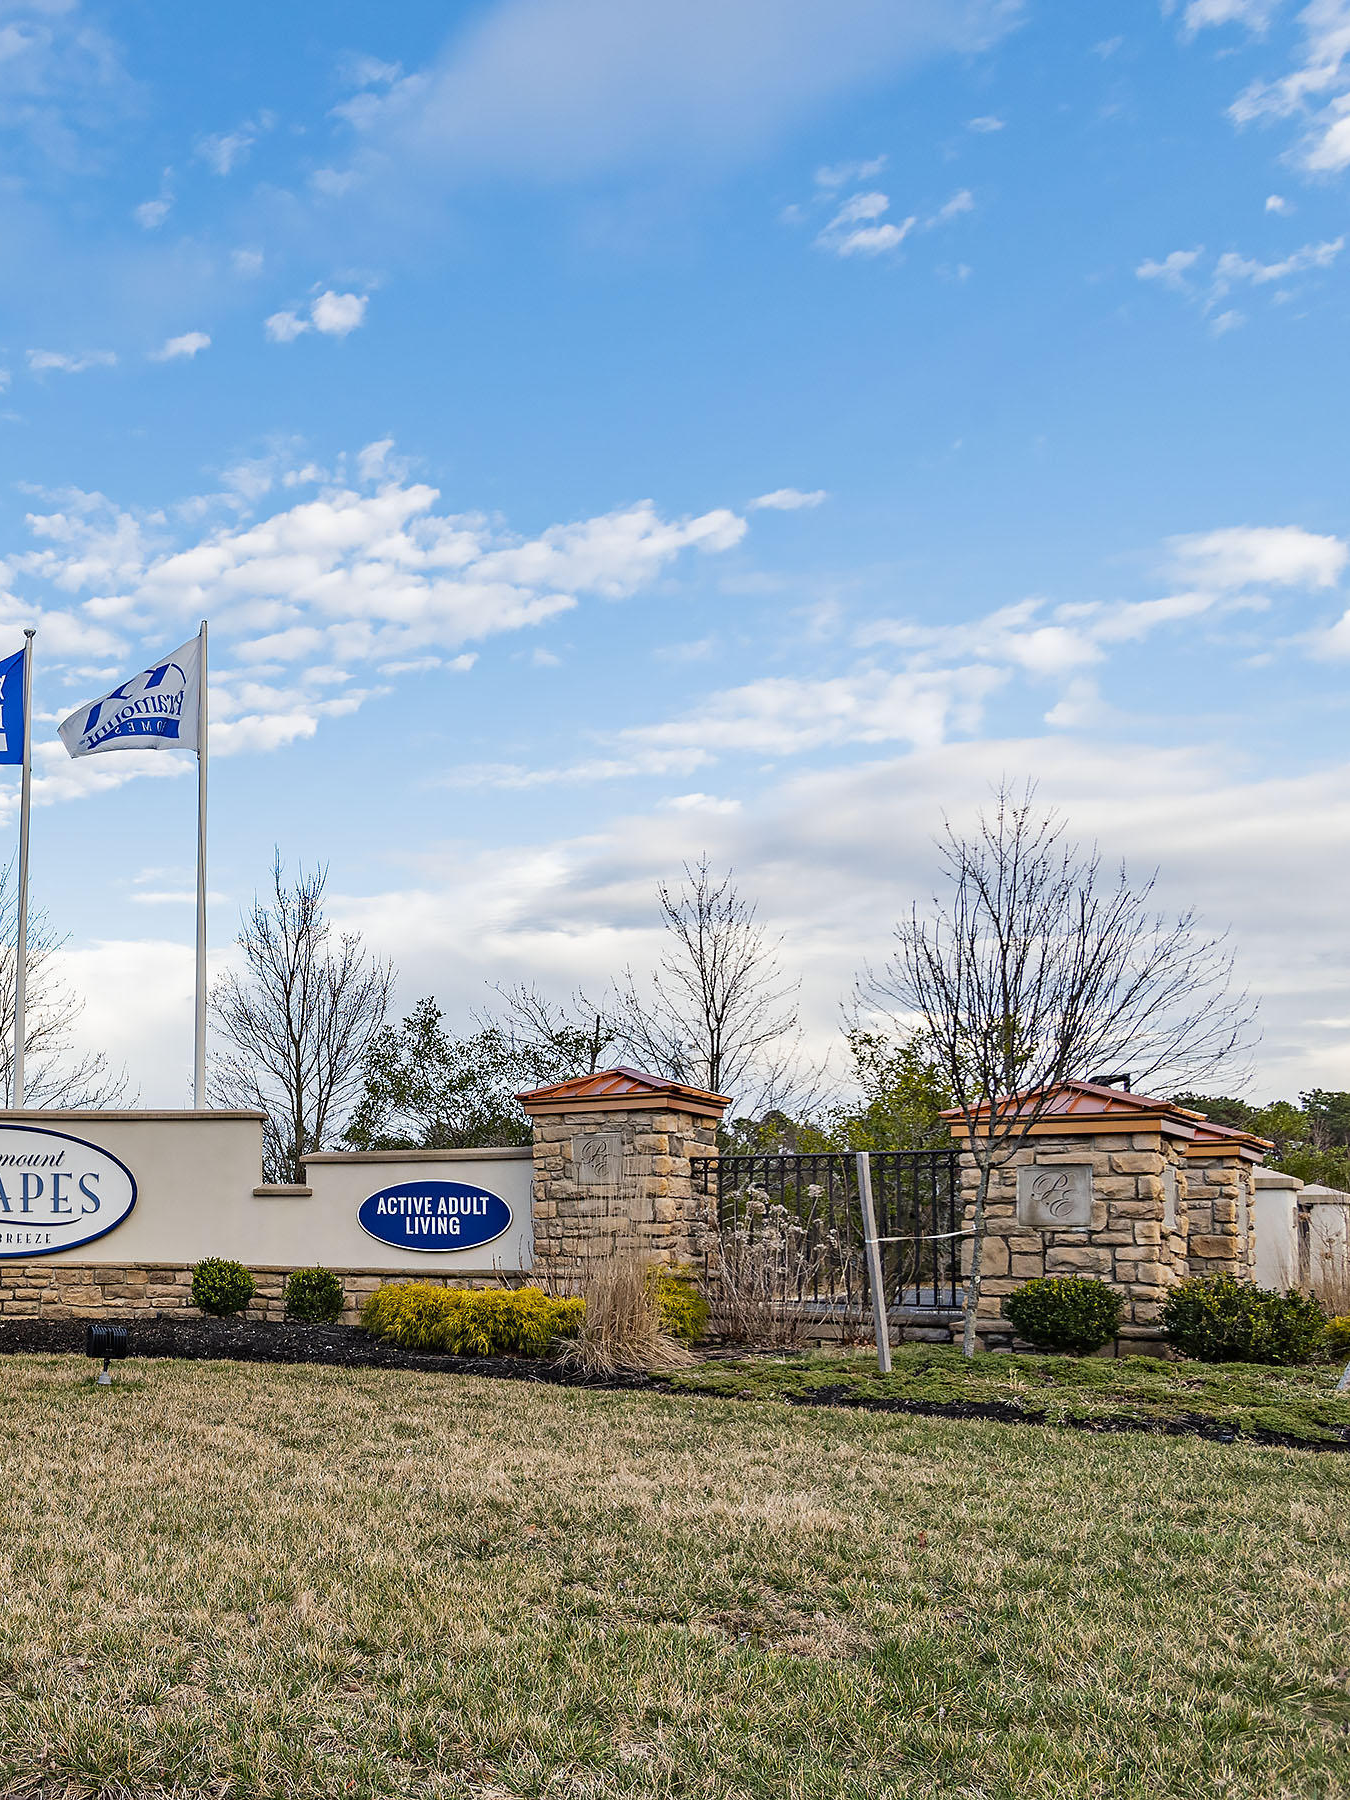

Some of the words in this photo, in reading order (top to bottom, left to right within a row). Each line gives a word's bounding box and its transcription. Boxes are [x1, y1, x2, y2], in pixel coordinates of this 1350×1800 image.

[376, 1197, 432, 1215] ACTIVE
[437, 1197, 489, 1215] ADULT
[405, 1216, 460, 1235] LIVING
